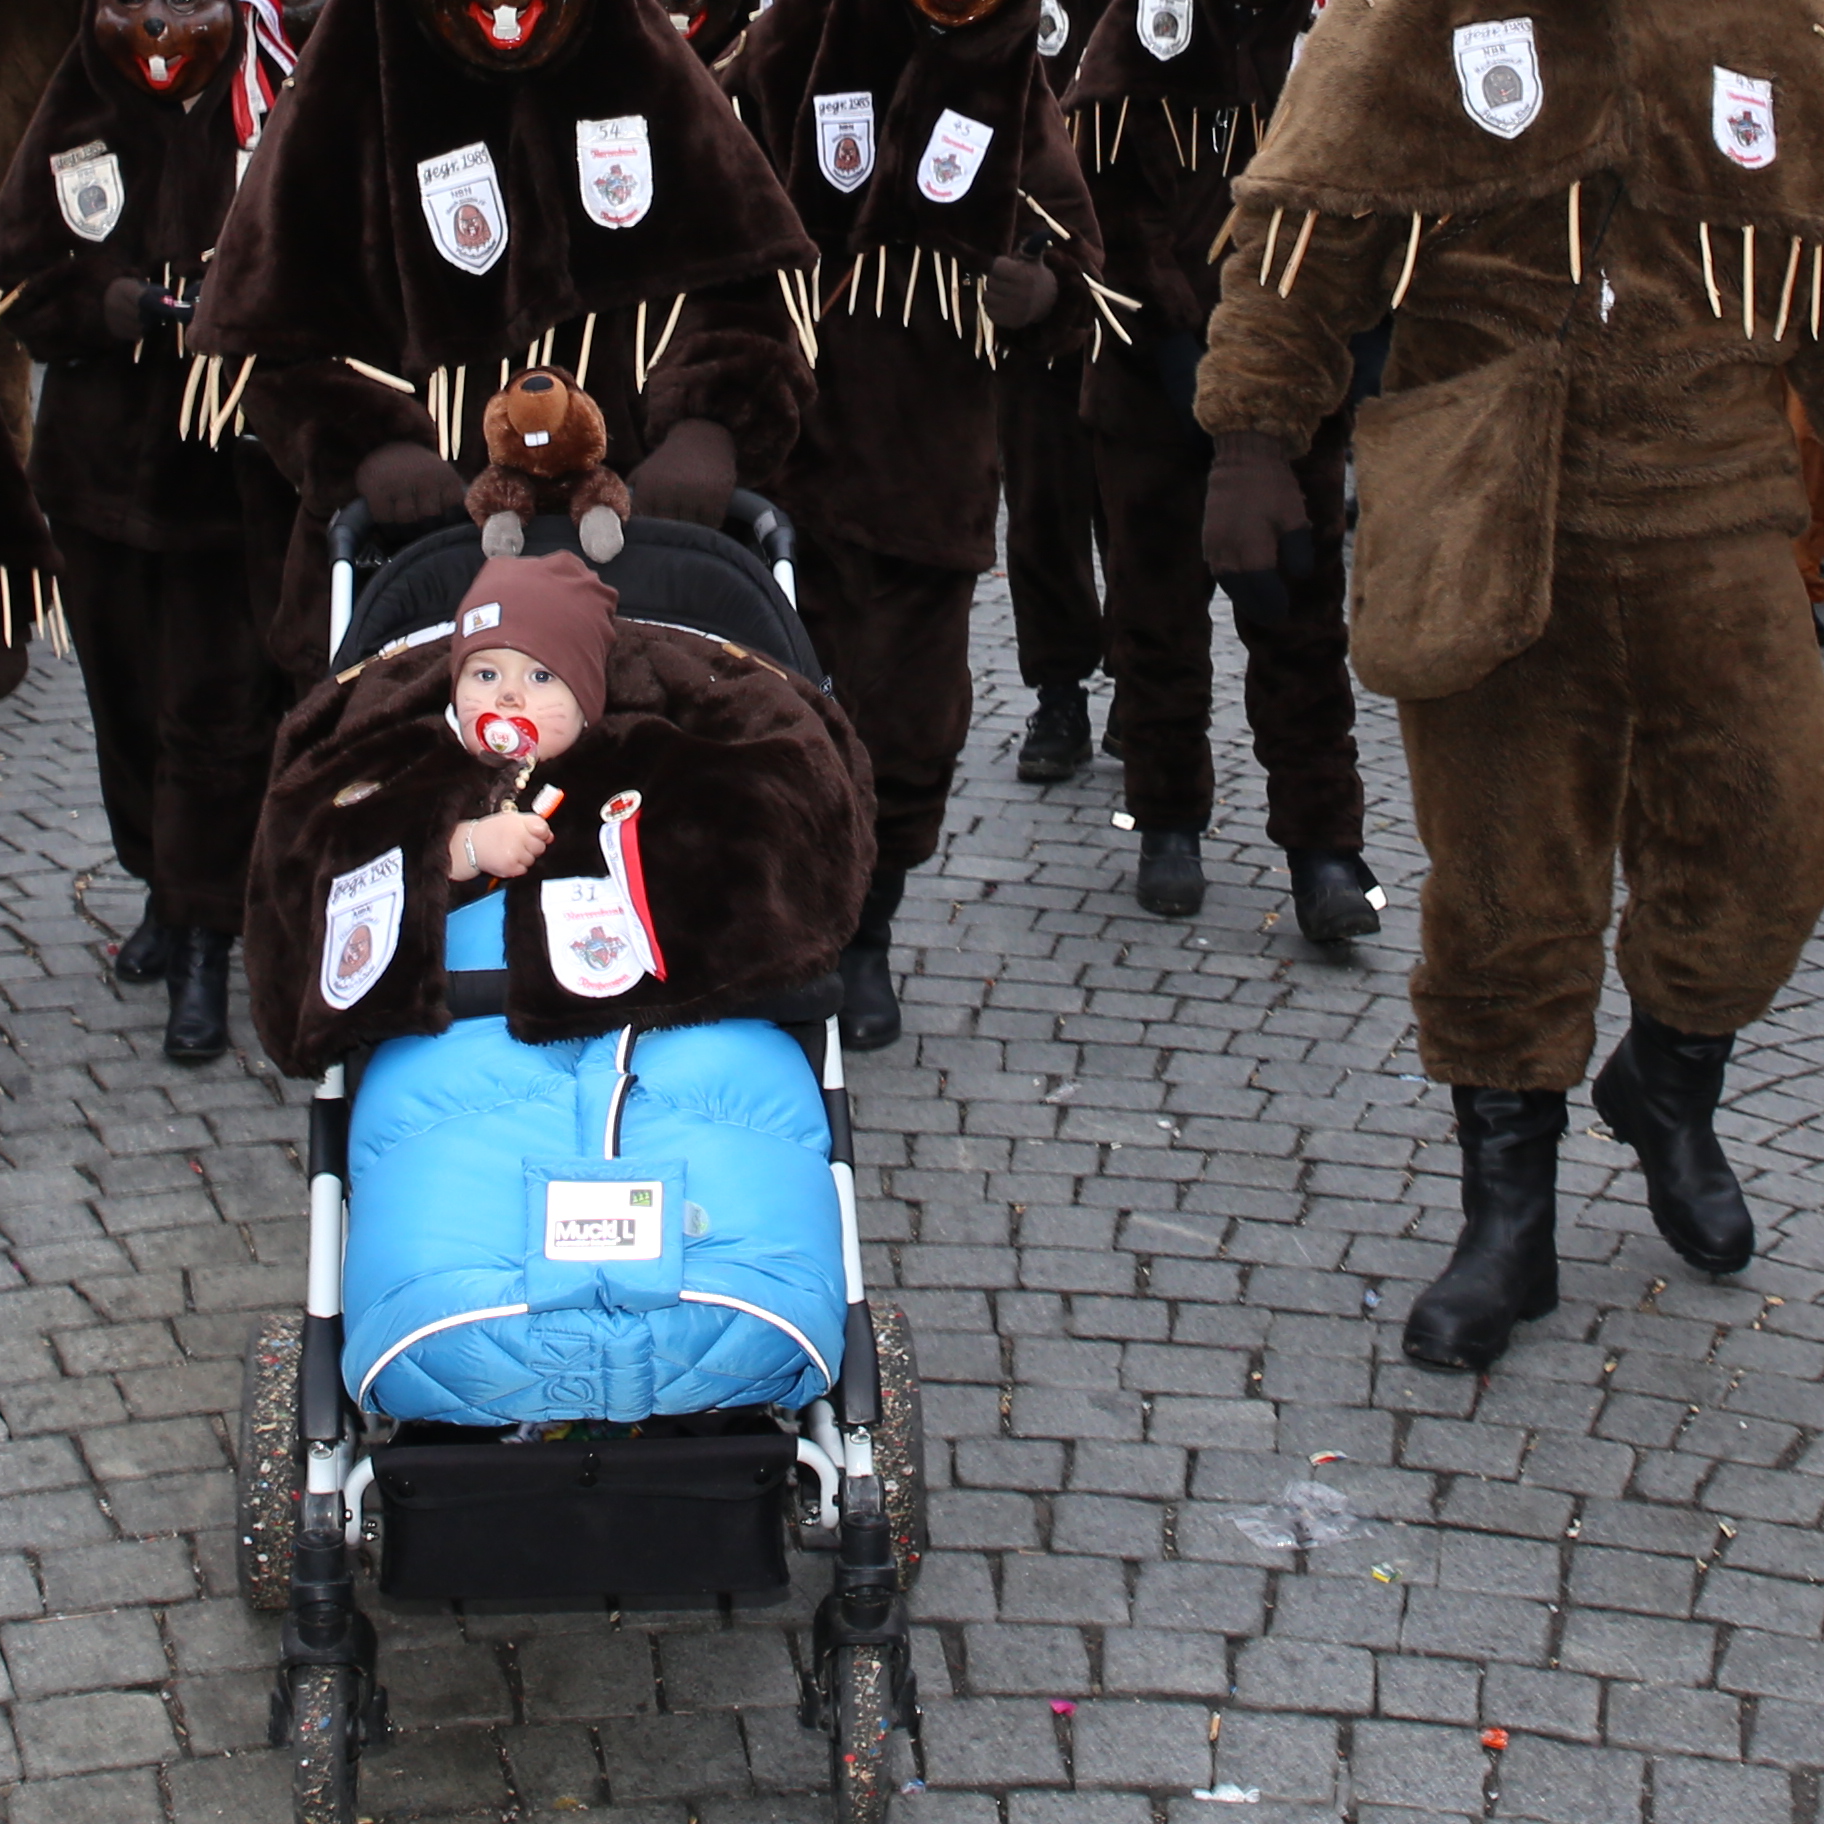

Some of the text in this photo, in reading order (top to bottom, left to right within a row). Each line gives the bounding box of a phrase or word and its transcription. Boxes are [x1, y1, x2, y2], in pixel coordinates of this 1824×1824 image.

[598, 122, 621, 139] 54
[571, 883, 598, 902] 31
[556, 1219, 618, 1241] Mucki
